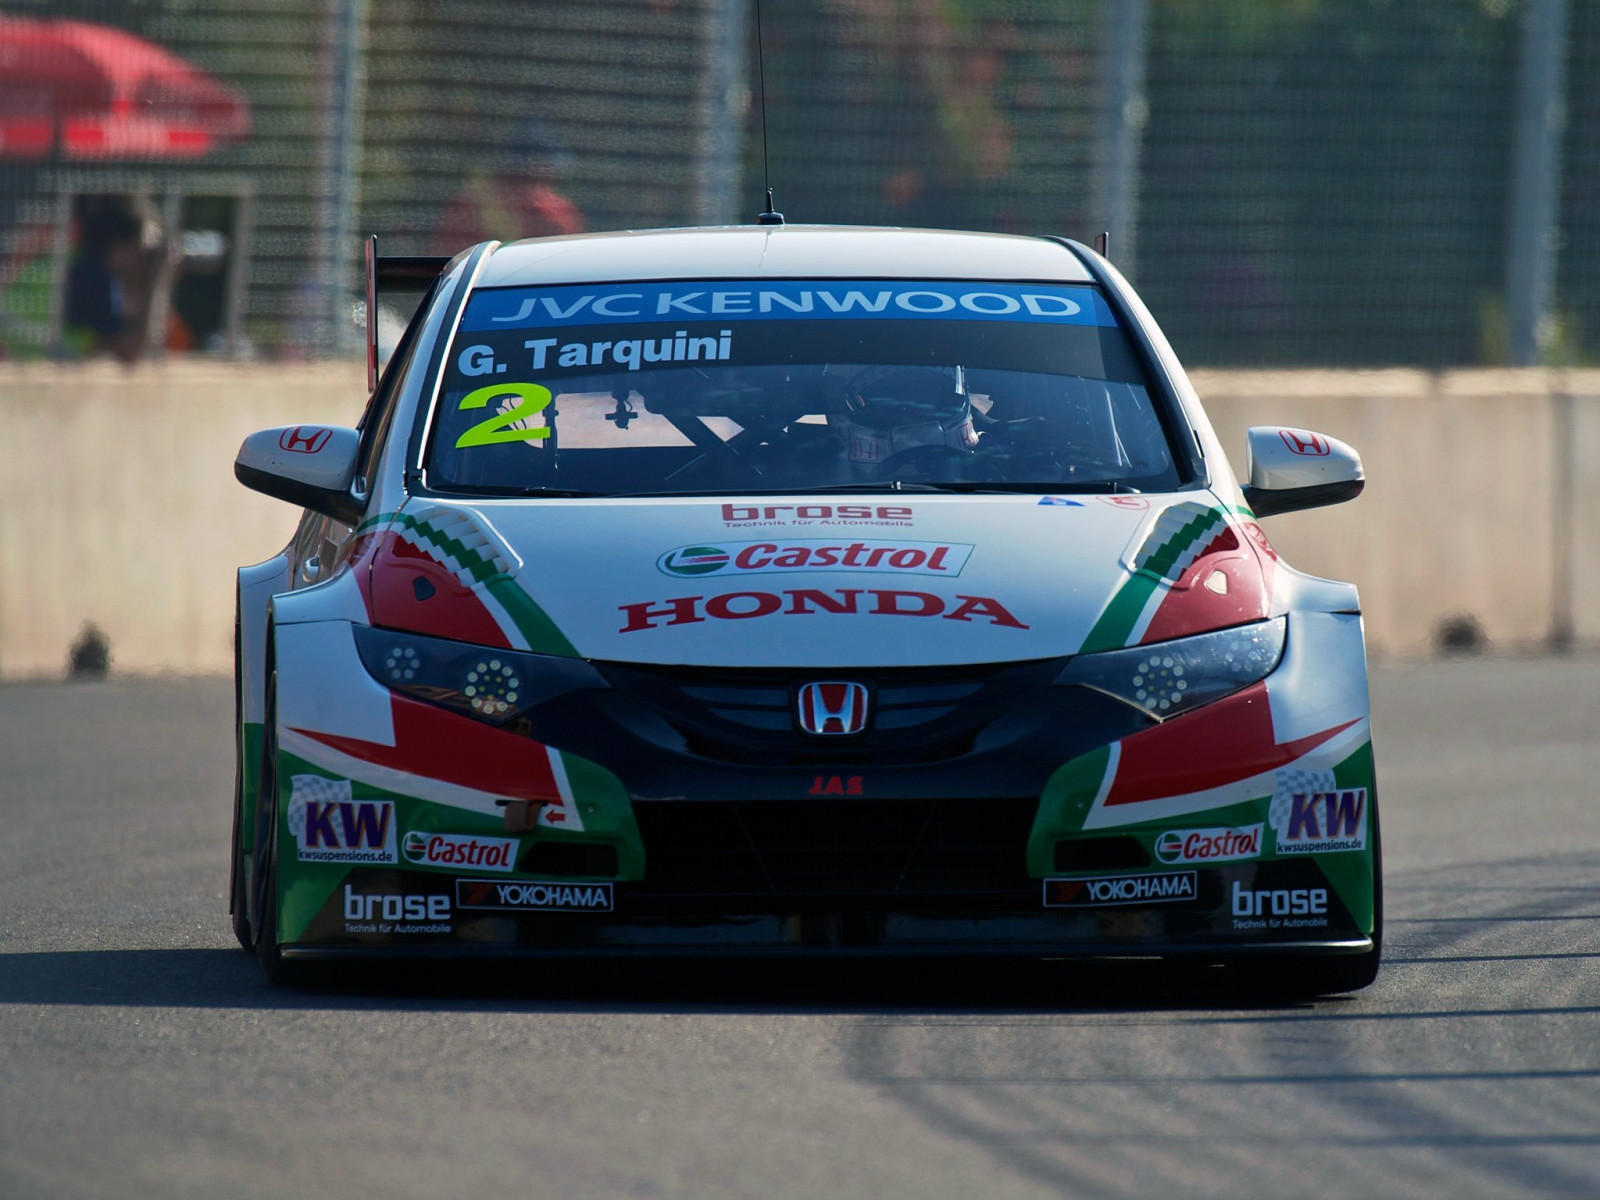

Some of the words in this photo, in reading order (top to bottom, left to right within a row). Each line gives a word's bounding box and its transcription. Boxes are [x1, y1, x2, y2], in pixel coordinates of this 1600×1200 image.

[457, 344, 508, 377] G.
[524, 329, 732, 371] Tarquini
[455, 382, 553, 449] 2
[721, 503, 913, 522] brose
[724, 520, 787, 528] Technik
[792, 519, 814, 527] für
[819, 519, 915, 528] Automobile
[734, 543, 951, 571] Castrol
[618, 589, 1030, 633] HONDA
[808, 776, 863, 795] JAS
[305, 802, 392, 850] KW
[1286, 790, 1365, 841] KW
[299, 849, 393, 862] kwsuspensions.de
[426, 836, 511, 868] Castrol
[1182, 827, 1259, 860] Castrol
[1277, 838, 1362, 853] kwsuspensions.de
[344, 884, 451, 920] brose
[496, 884, 608, 908] YOKOHAMA
[1086, 875, 1192, 901] YOKOHAMA
[1232, 880, 1328, 916] brose
[344, 923, 377, 934] Technik
[379, 923, 392, 933] für
[394, 923, 452, 934] Automobile
[1232, 918, 1267, 930] Technik
[1269, 918, 1281, 929] für
[1283, 917, 1328, 928] Automobile
